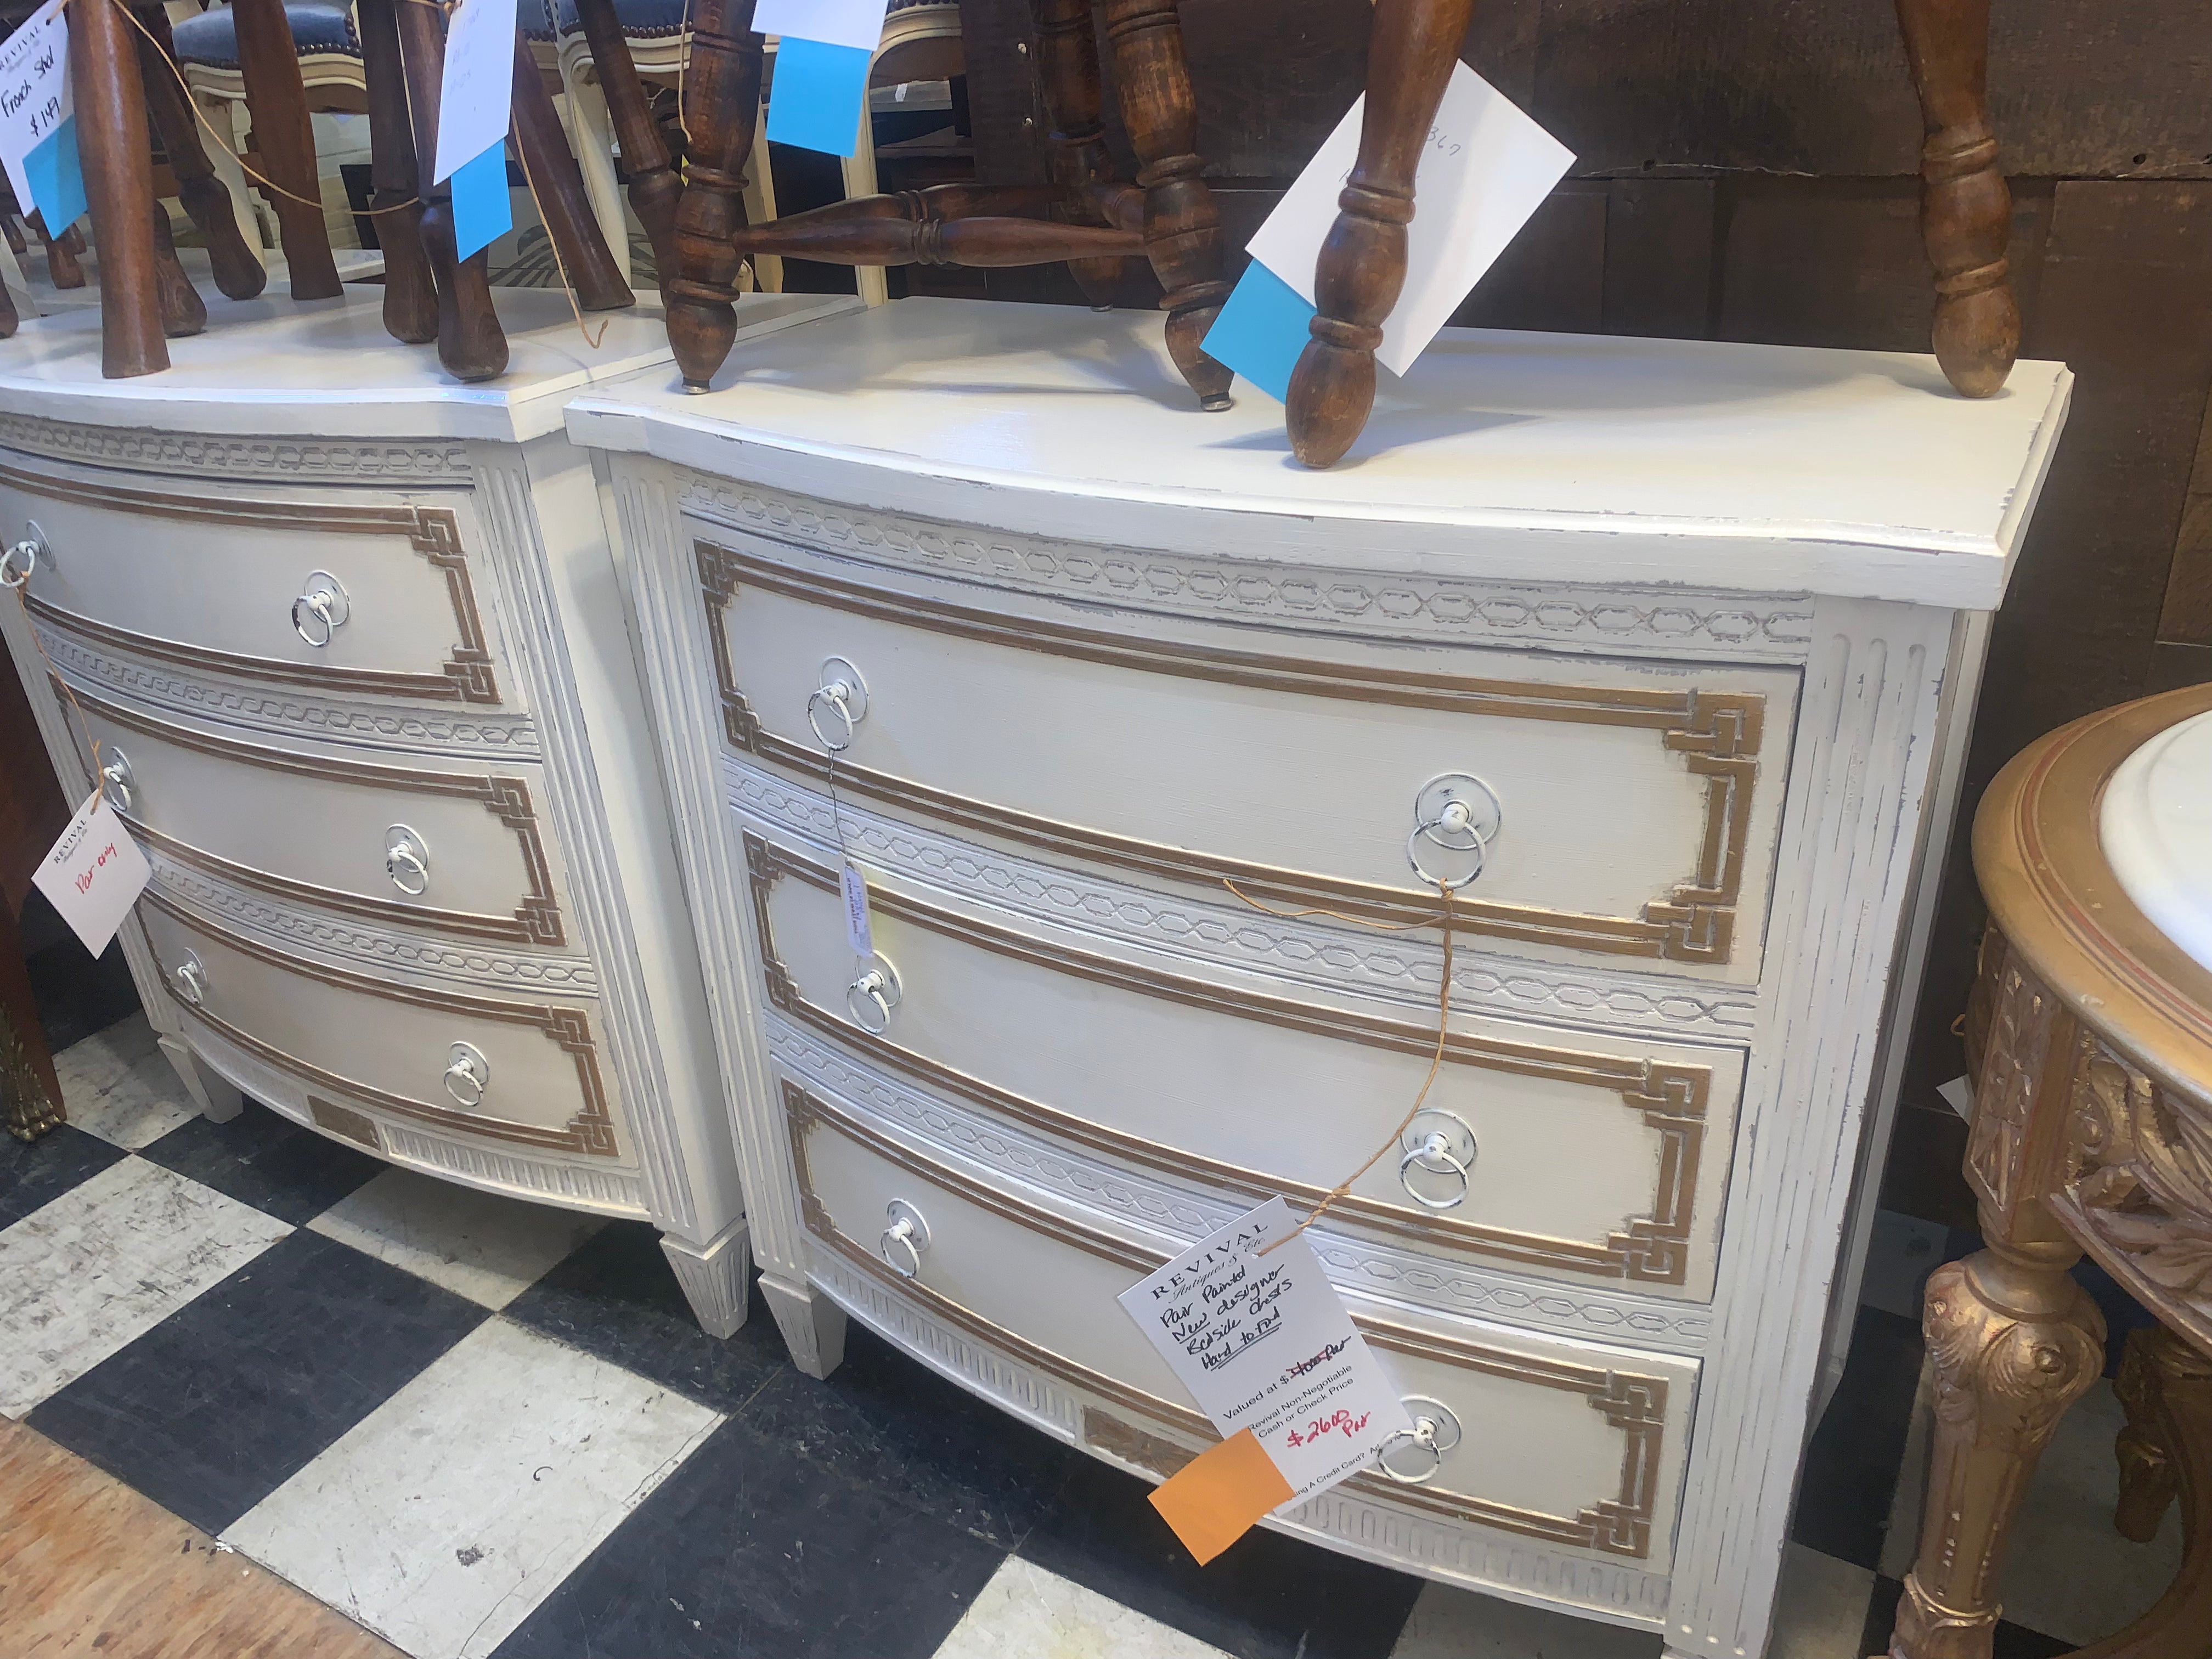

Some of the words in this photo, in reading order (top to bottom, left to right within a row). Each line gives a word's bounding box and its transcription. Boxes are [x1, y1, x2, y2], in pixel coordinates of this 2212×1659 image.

[54, 819, 87, 864] REVIVAL
[1151, 1223, 1268, 1300] REVIVAL
[1168, 1261, 1225, 1304] Antiques
[1160, 1302, 1193, 1328] Pair
[1201, 1264, 1246, 1304] Painted
[1172, 1312, 1210, 1344] New
[1217, 1263, 1284, 1316] designer
[1187, 1318, 1242, 1355] Bedside
[1201, 1342, 1232, 1370] Hard
[1240, 1331, 1255, 1345] to
[1223, 1391, 1264, 1420] Valued
[1266, 1383, 1278, 1395] at
[1248, 1408, 1281, 1430] Revival
[1281, 1365, 1352, 1412] Non-Negotiable
[1258, 1420, 1284, 1438] Cash
[1285, 1414, 1295, 1423] or
[1297, 1393, 1328, 1415] Check
[1328, 1378, 1354, 1396] Price
[1316, 1468, 1341, 1483] Credit
[1341, 1452, 1365, 1469] Card?
